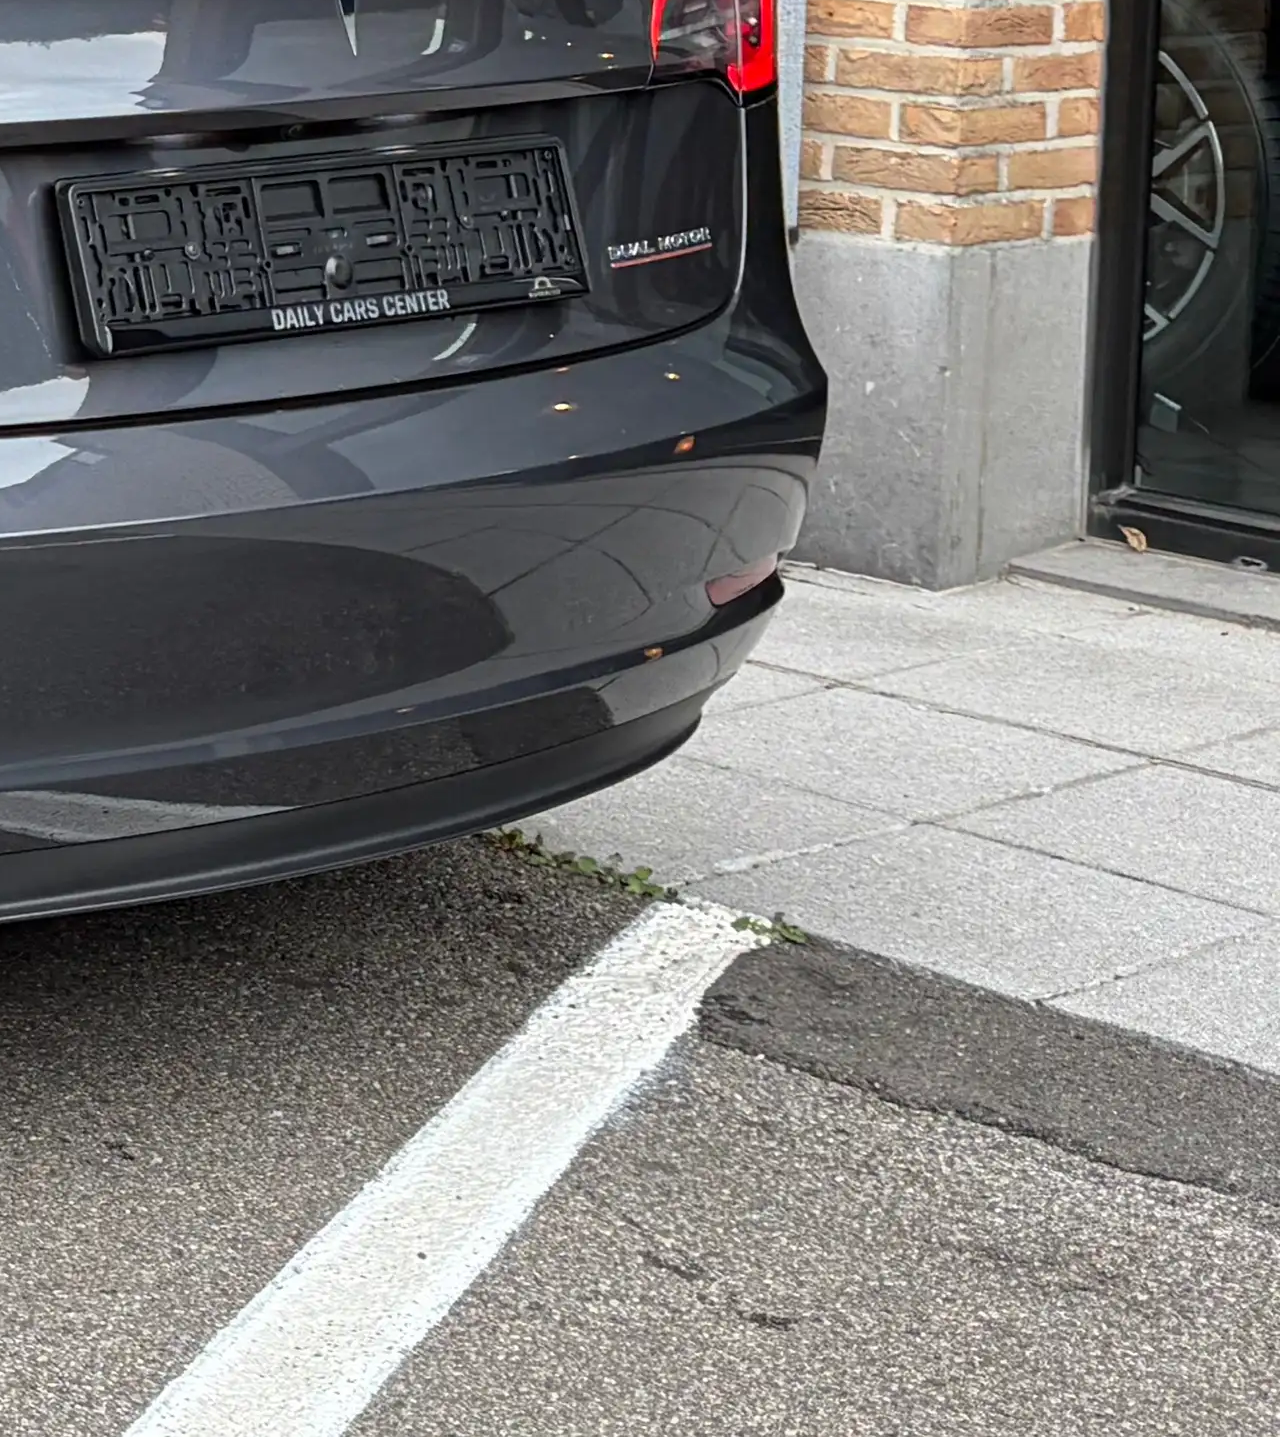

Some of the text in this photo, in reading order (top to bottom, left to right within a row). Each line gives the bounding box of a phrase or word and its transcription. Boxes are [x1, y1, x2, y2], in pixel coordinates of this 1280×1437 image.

[607, 226, 712, 261] DUAL MOTOR
[272, 289, 451, 331] DAILY CARS CENTER
